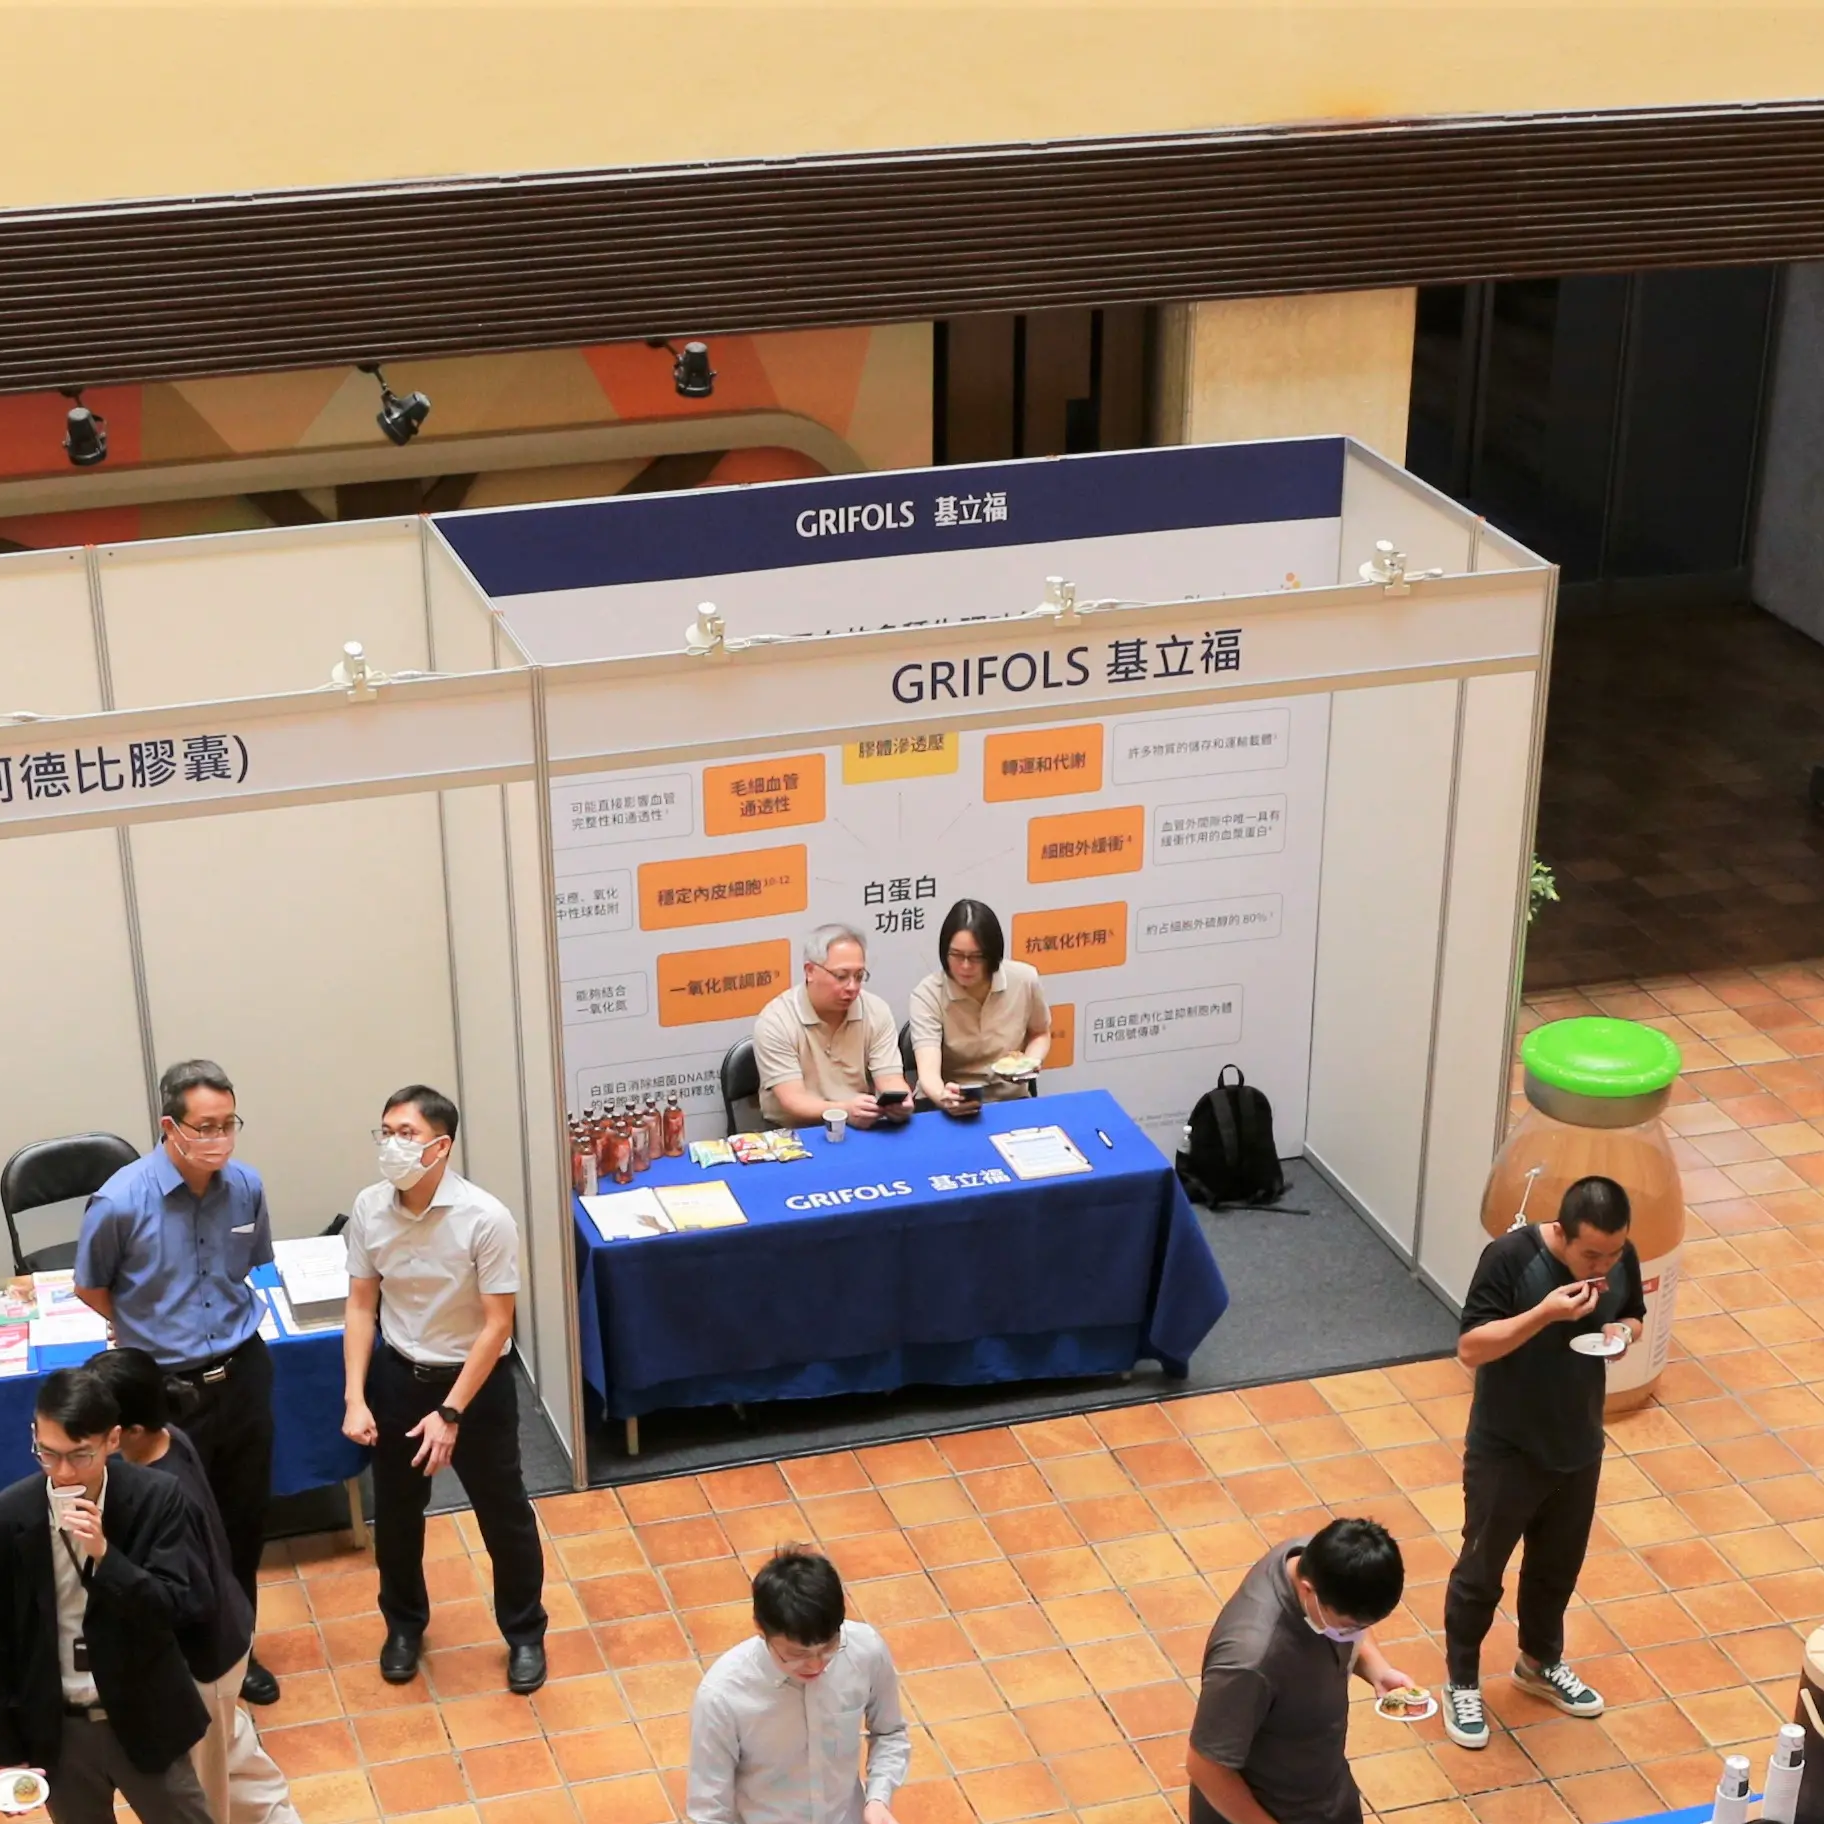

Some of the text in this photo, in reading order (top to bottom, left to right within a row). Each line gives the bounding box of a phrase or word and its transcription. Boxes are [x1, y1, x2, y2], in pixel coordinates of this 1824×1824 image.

[796, 492, 1008, 537] GRIFOLS 基立福
[892, 628, 1243, 704] GRIFOLS 基立福
[1001, 752, 1086, 776] 轉運和代謝
[730, 773, 800, 797] 毛細血管
[739, 796, 791, 818] 通透性
[863, 875, 936, 906] 白蛋白
[875, 907, 925, 933] 功能
[576, 999, 628, 1016] 一氧化氮
[785, 1168, 1011, 1210] GRIFOLS 基立福
